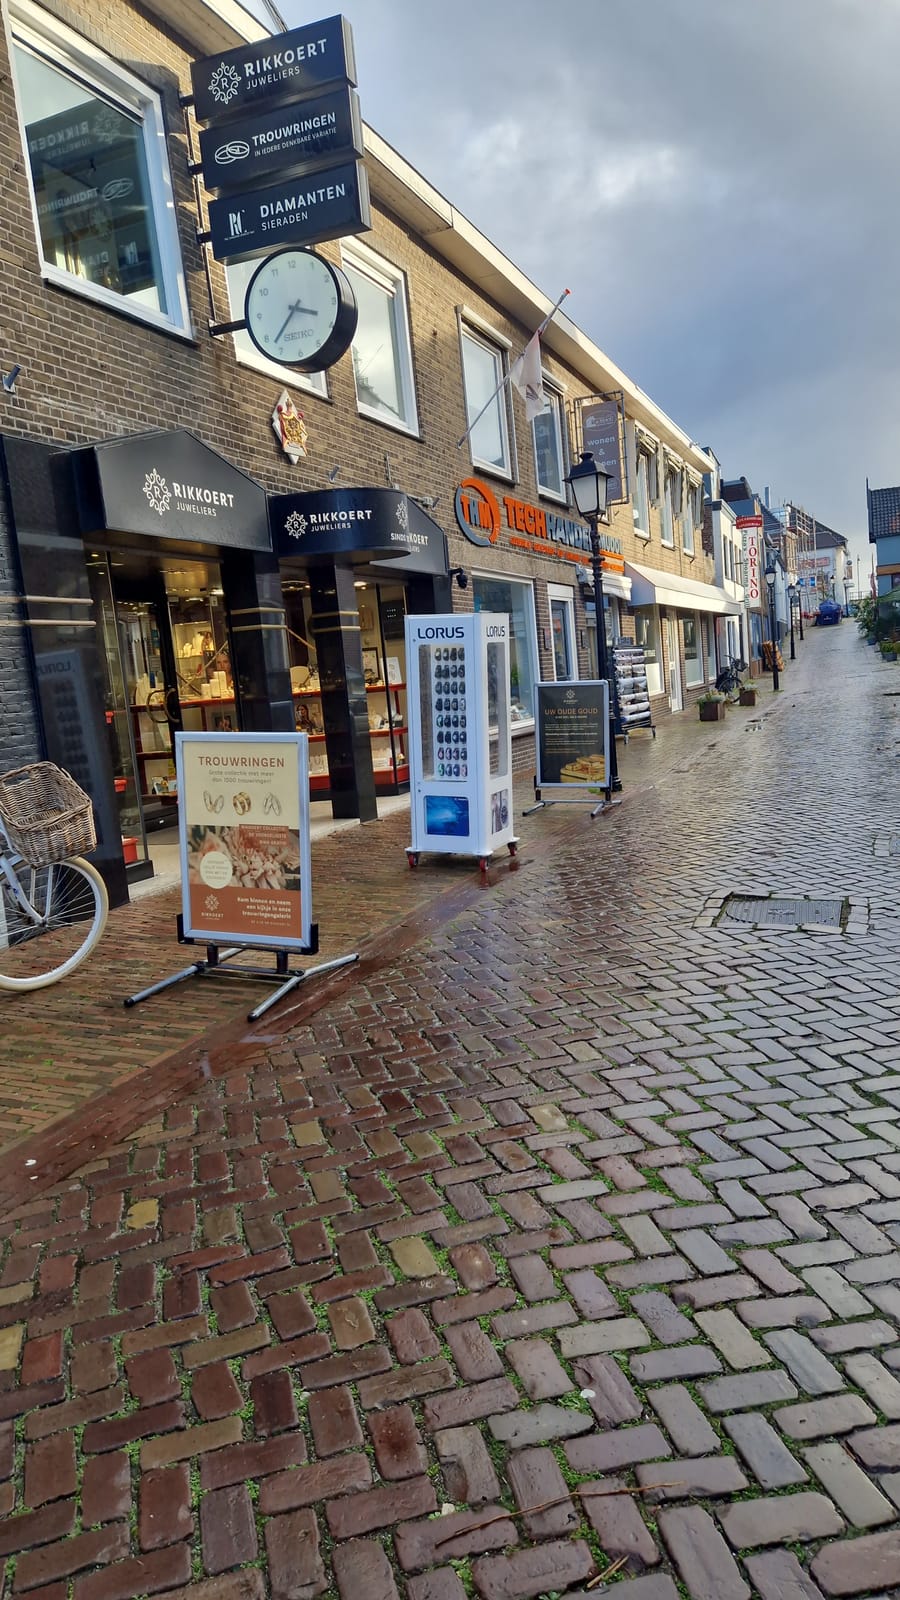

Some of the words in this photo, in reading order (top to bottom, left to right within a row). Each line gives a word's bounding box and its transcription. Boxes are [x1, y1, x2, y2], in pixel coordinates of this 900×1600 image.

[244, 39, 327, 77] RIKKOERT
[246, 66, 300, 90] JUWELIERS
[252, 112, 336, 146] TROUWRINGEN
[262, 144, 280, 154] IEDERE
[282, 134, 311, 149] DENKBARE
[312, 127, 336, 140] VARIATIE
[260, 184, 346, 218] DIAMANTEN
[261, 211, 308, 231] SIERADEN
[288, 260, 296, 268] 12
[310, 262, 314, 270] 1
[272, 269, 278, 277] 11
[259, 288, 268, 296] 10
[283, 329, 314, 342] SEIKO
[587, 436, 615, 445] wonen
[172, 482, 234, 508] RIKKOERT
[176, 502, 216, 516] JUWELIERS
[460, 495, 492, 530] THM
[310, 510, 372, 524] RIKKOERT
[311, 522, 351, 532] JUWELIERS
[749, 536, 758, 598] TORINO
[418, 626, 465, 639] LORUS
[486, 626, 505, 637] LORUS
[198, 756, 284, 767] TROUWRINGEN
